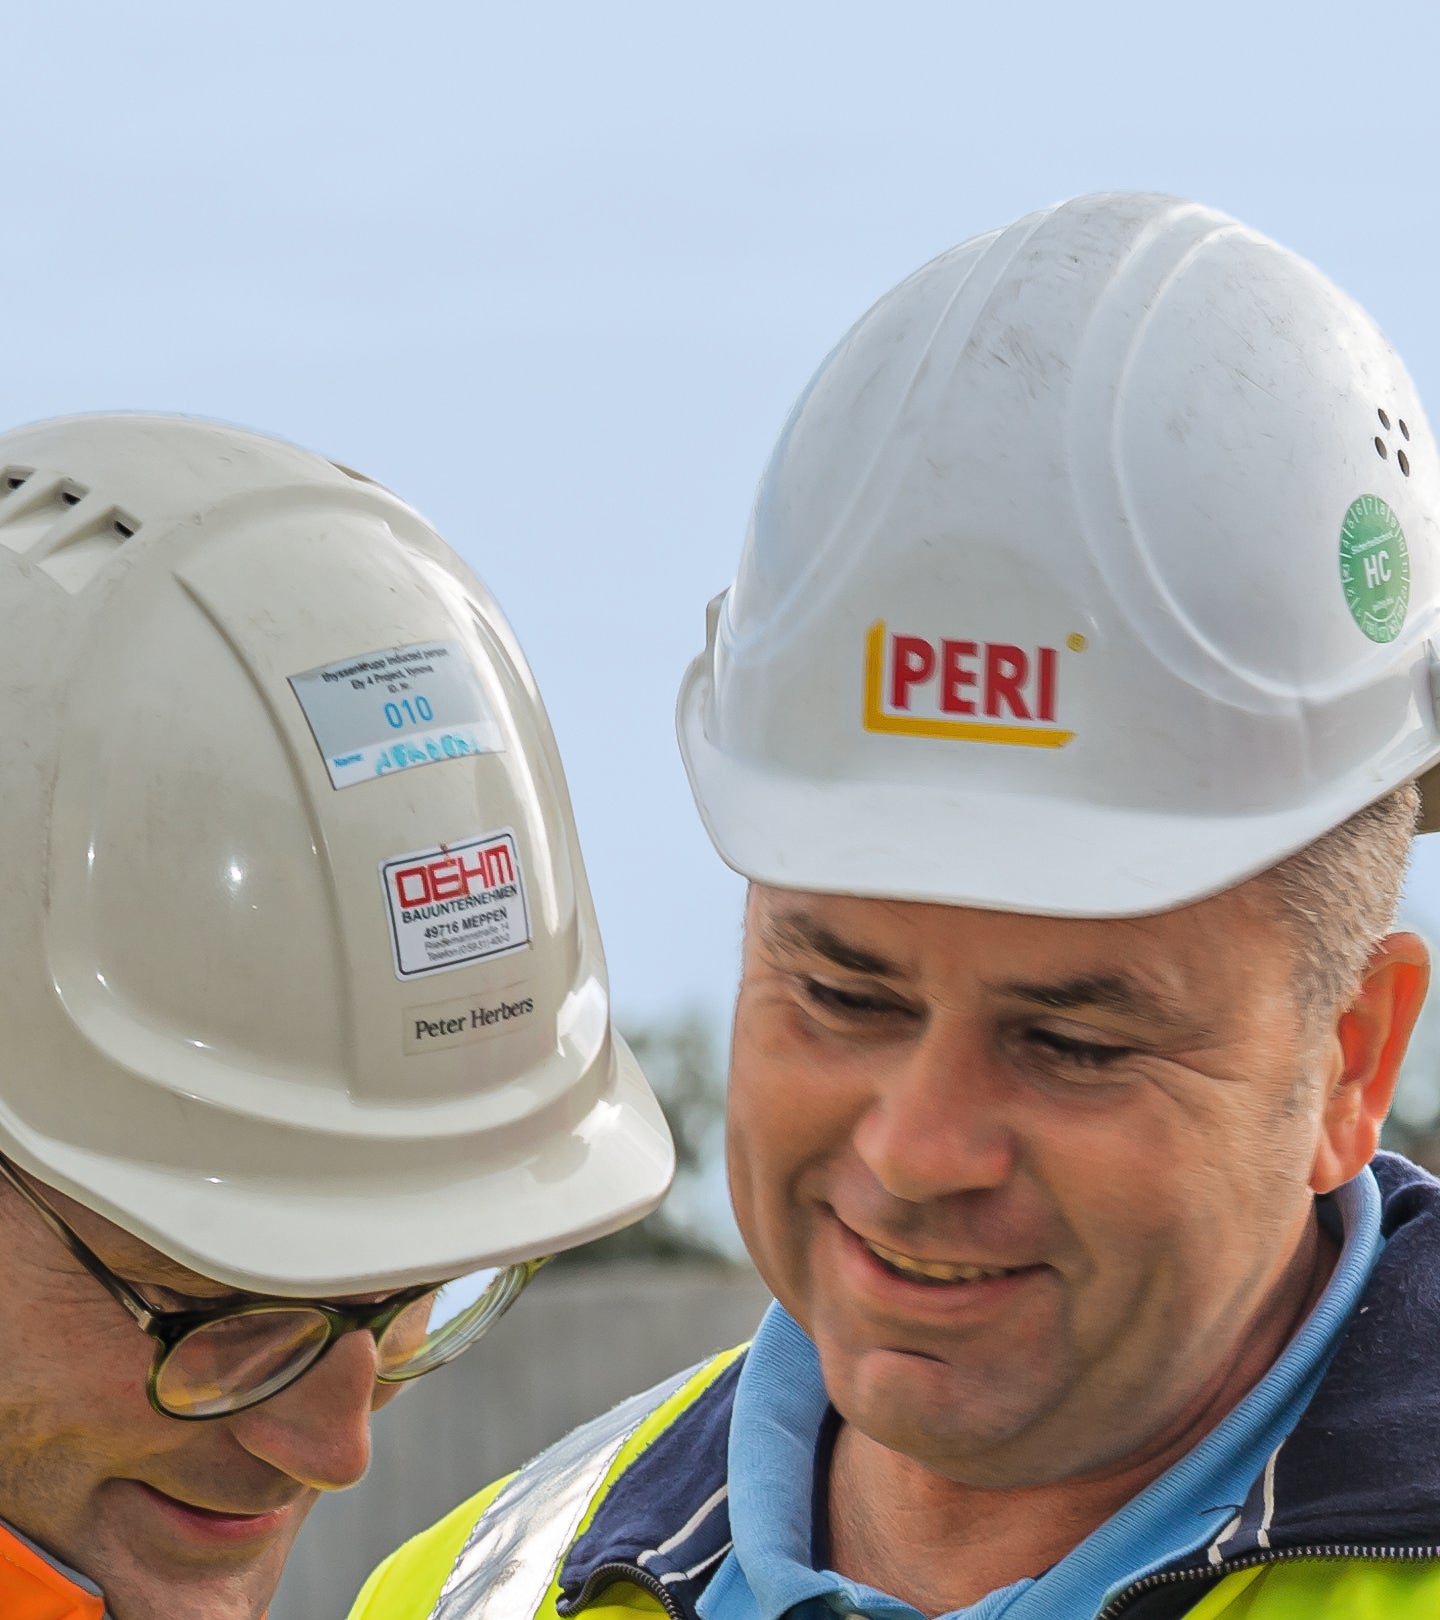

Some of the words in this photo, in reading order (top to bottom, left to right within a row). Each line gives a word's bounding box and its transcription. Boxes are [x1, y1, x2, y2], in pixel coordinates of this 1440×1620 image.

[1363, 550, 1392, 589] HC
[889, 632, 1058, 722] PERI
[383, 695, 434, 729] 010
[394, 844, 515, 910] OEHM
[401, 885, 518, 925] BAUUNTERNEHMEN
[423, 921, 460, 939] 49716
[461, 906, 508, 931] MEPPEN
[415, 1016, 467, 1040] Peter
[470, 997, 534, 1029] Herbers
